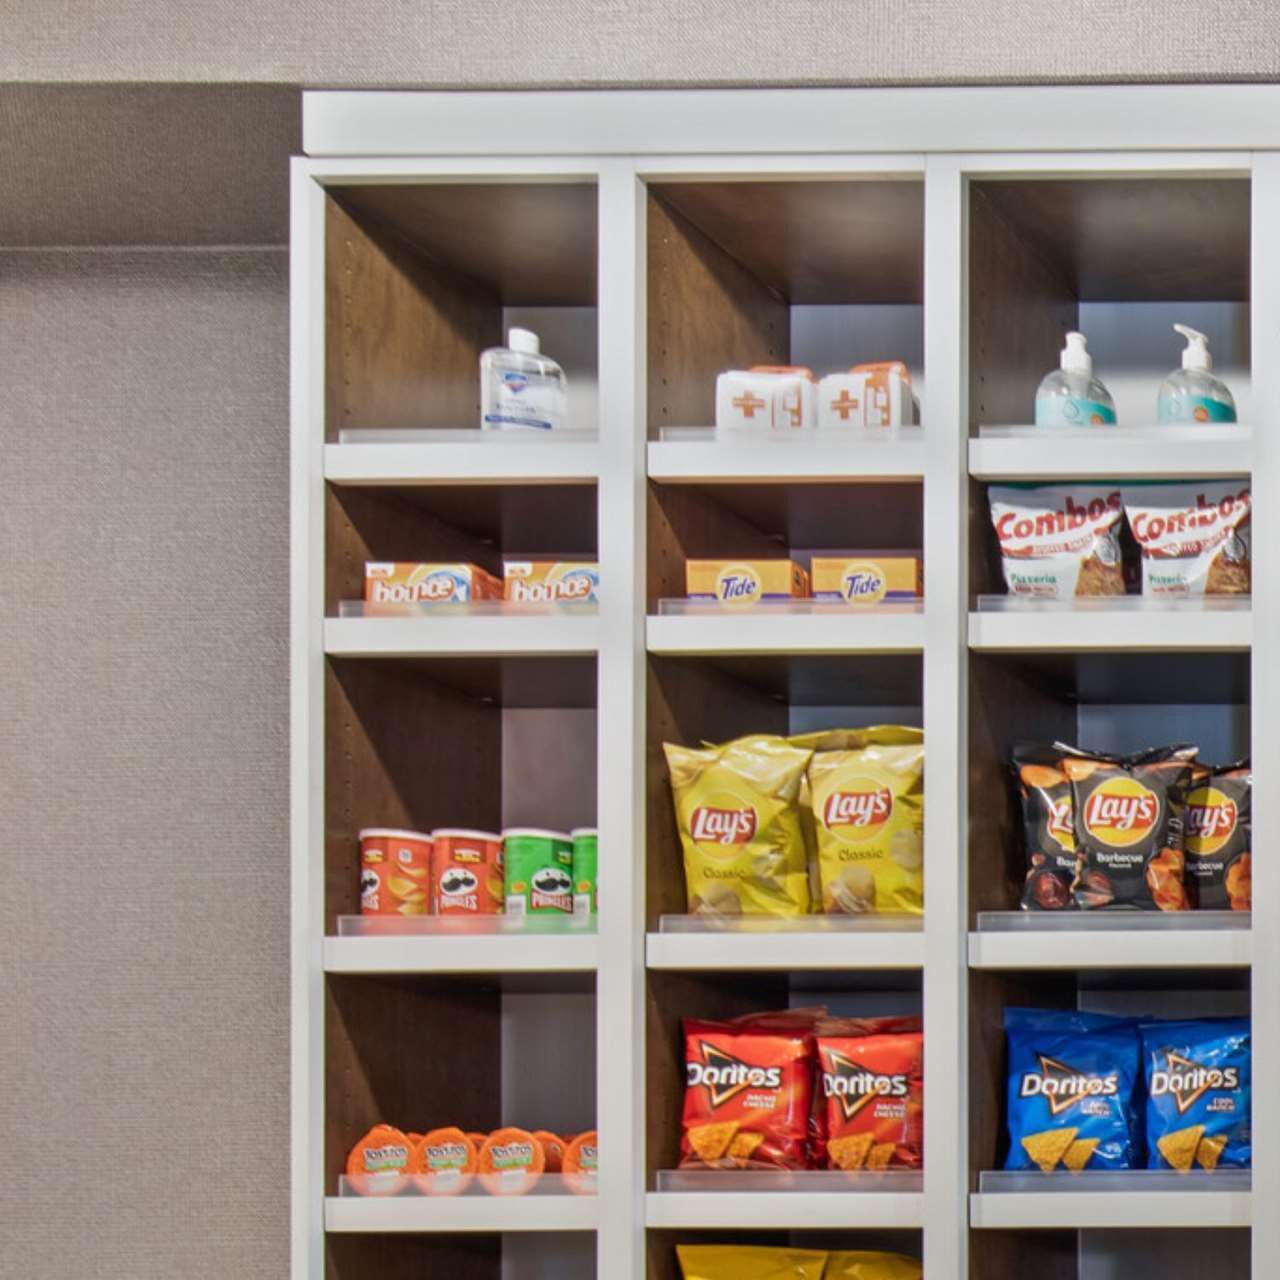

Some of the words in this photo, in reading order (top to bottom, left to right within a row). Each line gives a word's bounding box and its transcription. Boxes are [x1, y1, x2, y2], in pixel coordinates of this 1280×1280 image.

[995, 491, 1121, 541] Combos
[1131, 488, 1250, 542] Combos
[374, 577, 455, 602] bounce
[511, 577, 592, 602] bounce
[721, 577, 757, 599] Tide
[846, 574, 881, 598] Tide
[828, 788, 888, 827] Lay's
[1090, 793, 1153, 840] Lay's
[694, 808, 752, 844] Lay's
[1187, 802, 1234, 840] ay's
[1097, 852, 1143, 864] Barbecue
[687, 1062, 781, 1087] Doritos
[824, 1072, 907, 1097] Doritos
[1021, 1074, 1118, 1097] Doritos
[1152, 1066, 1237, 1096] Doritos
